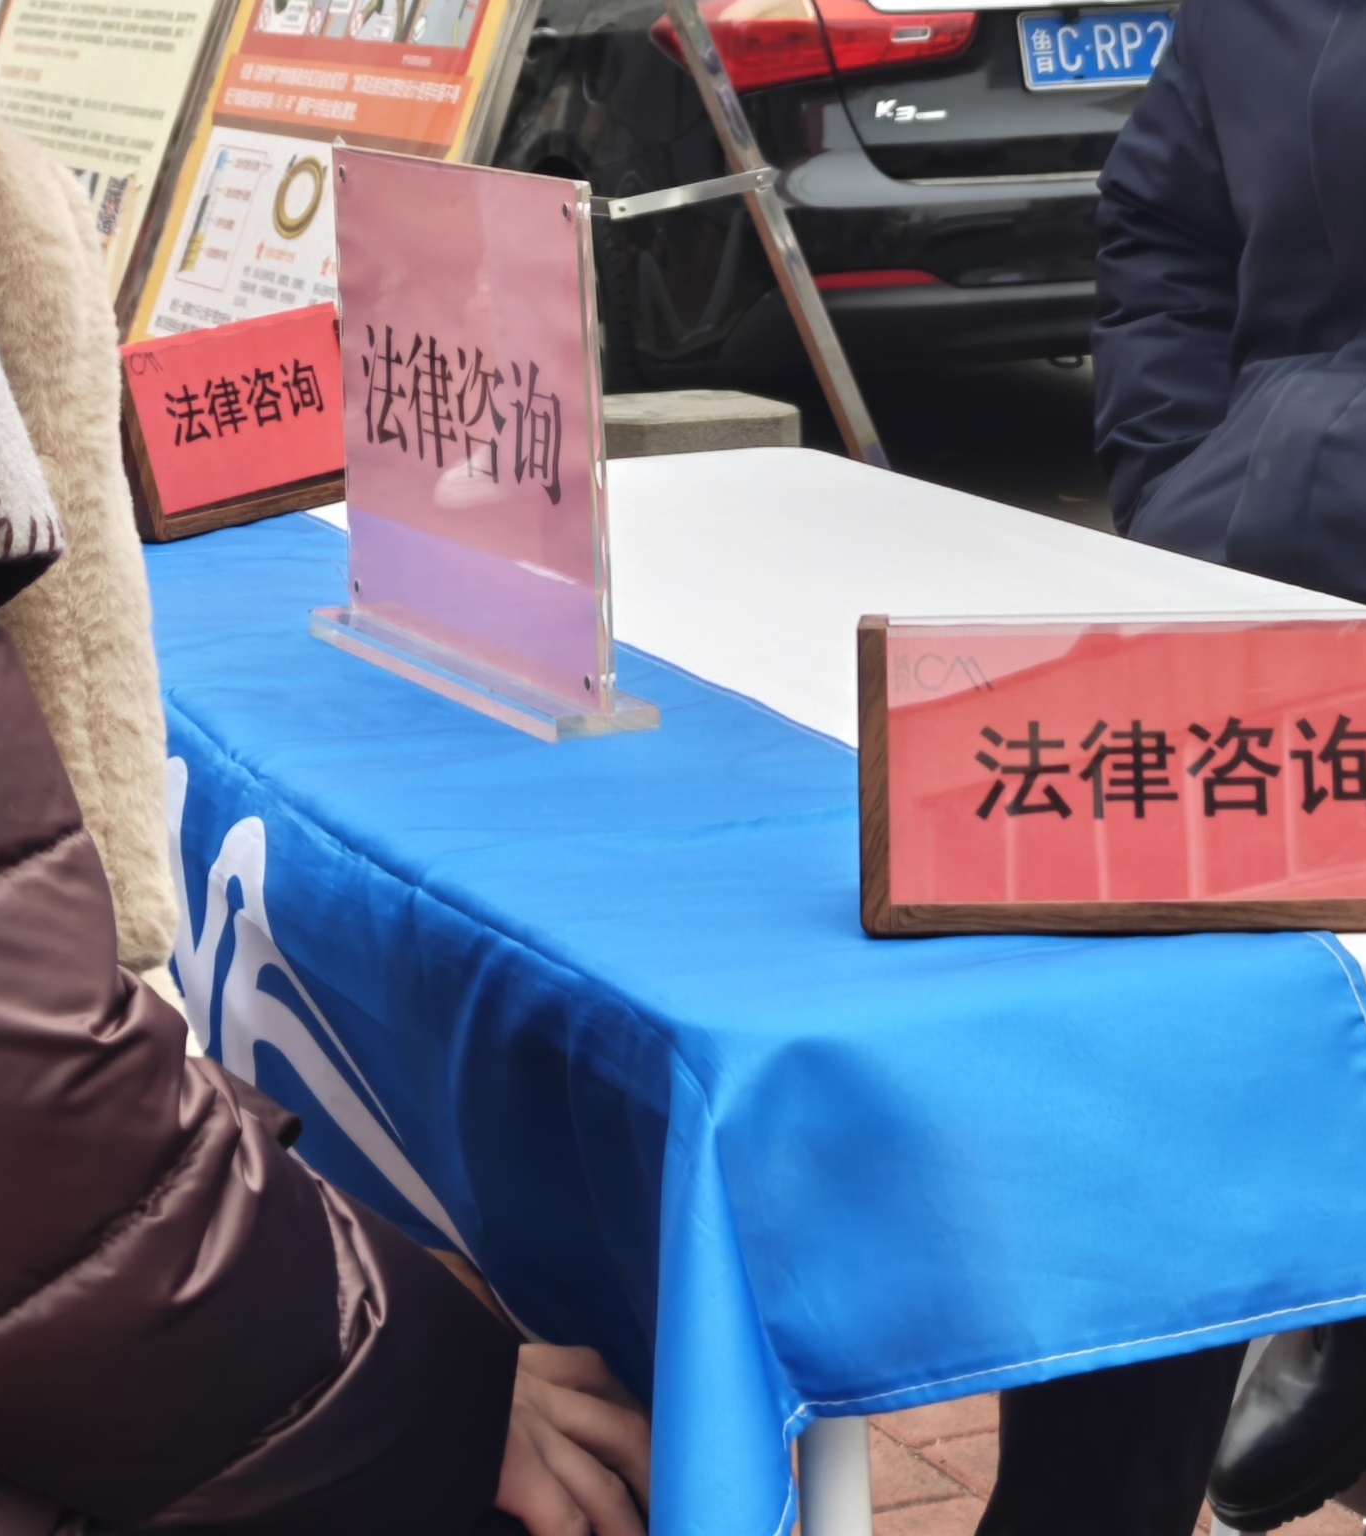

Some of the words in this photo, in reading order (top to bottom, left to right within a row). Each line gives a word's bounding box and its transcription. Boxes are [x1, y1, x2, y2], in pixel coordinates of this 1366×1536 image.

[165, 358, 325, 448] 法律咨询
[361, 323, 563, 506] 法律咨询
